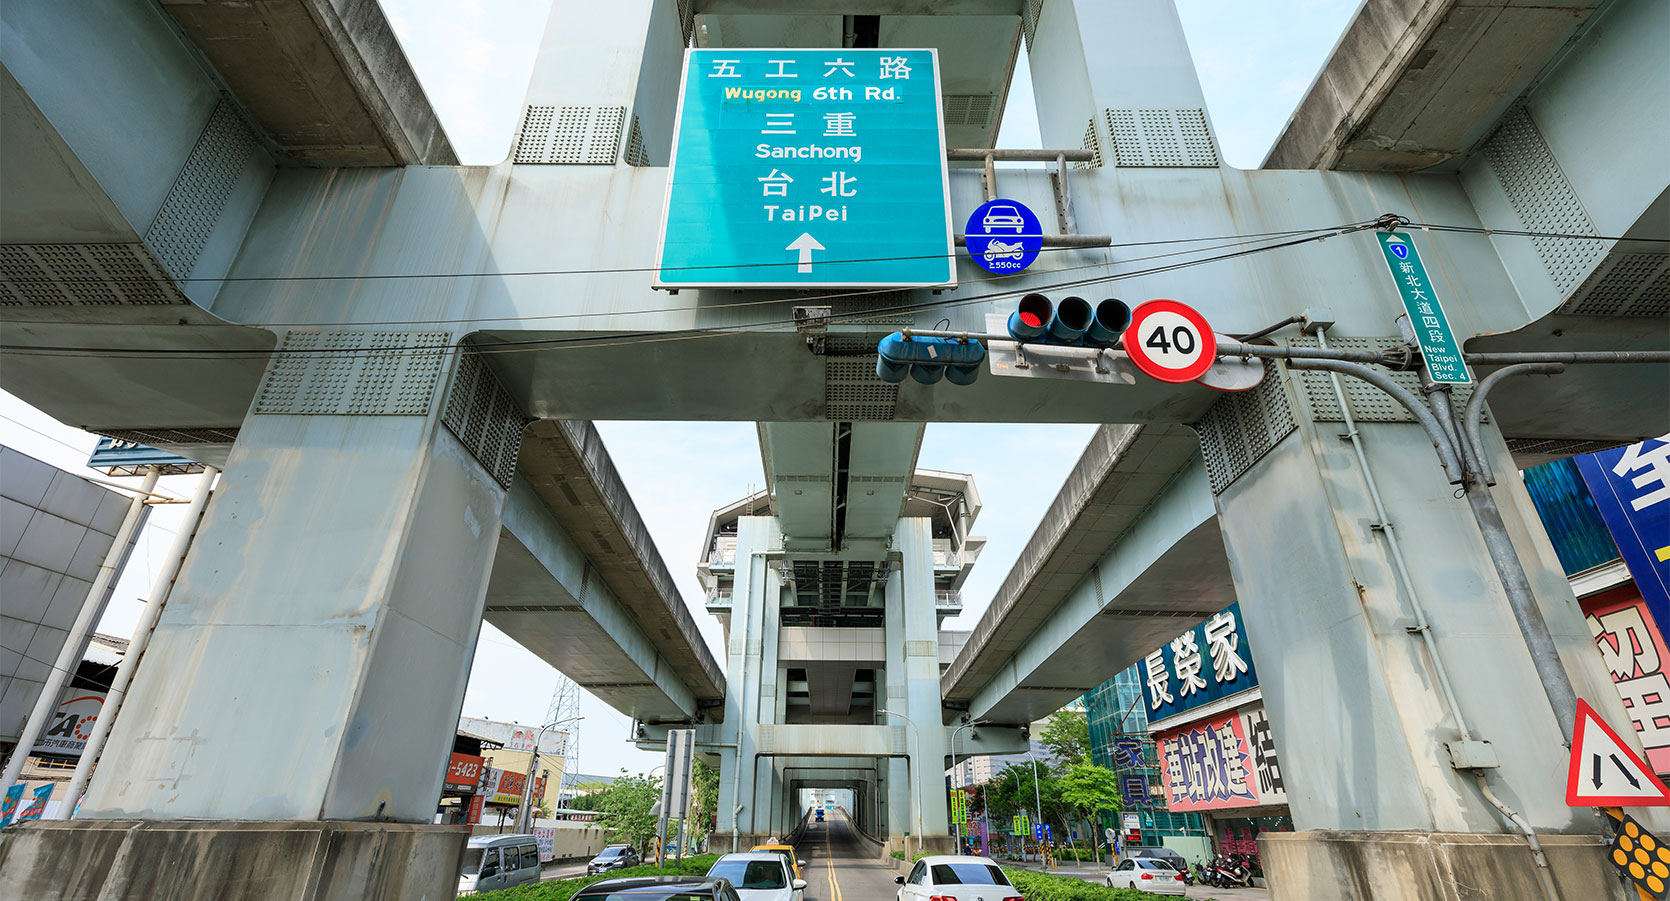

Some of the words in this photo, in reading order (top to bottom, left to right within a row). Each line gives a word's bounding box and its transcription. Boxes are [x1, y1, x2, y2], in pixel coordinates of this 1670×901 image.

[708, 56, 912, 80] 五工六路
[724, 87, 802, 103] Wugong
[812, 87, 852, 101] 6th
[865, 86, 900, 101] Rd.
[761, 112, 857, 137] 三重
[755, 144, 862, 162] Sanchong
[758, 168, 858, 197] 台北
[1398, 261, 1446, 344] 新北大道四段
[1146, 325, 1195, 354] 40
[1424, 345, 1446, 353] New
[1428, 354, 1458, 364] Taipei
[1431, 363, 1457, 371] Blvd.
[1435, 371, 1457, 380] Sec.
[1459, 372, 1466, 380] 4
[1145, 611, 1248, 710] 長榮家
[449, 760, 478, 778] -5423
[1114, 737, 1152, 807] 家具
[1164, 723, 1248, 802] 車站改建
